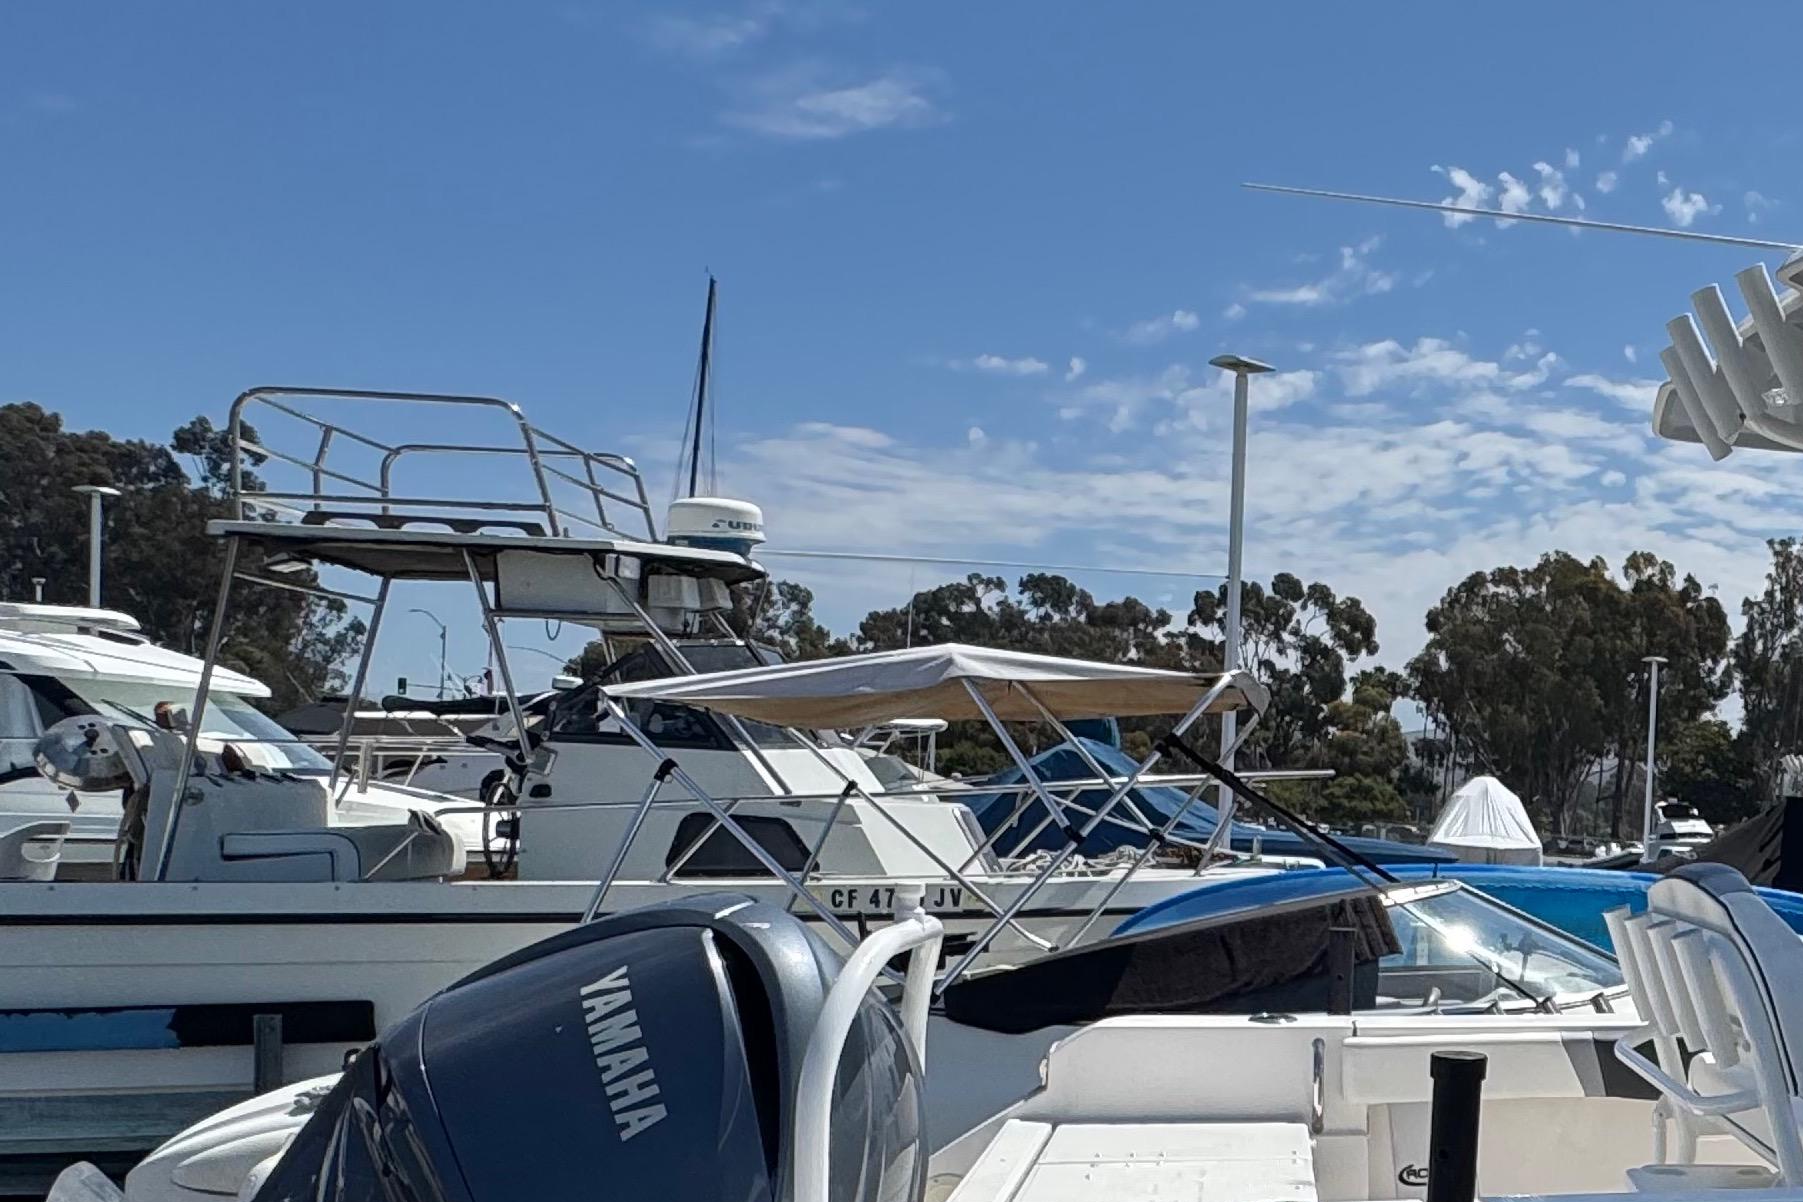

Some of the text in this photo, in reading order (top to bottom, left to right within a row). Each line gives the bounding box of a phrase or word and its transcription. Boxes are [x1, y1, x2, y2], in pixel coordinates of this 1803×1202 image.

[831, 888, 858, 909] CF
[933, 887, 963, 908] JV
[579, 964, 669, 1142] YAMAHA
